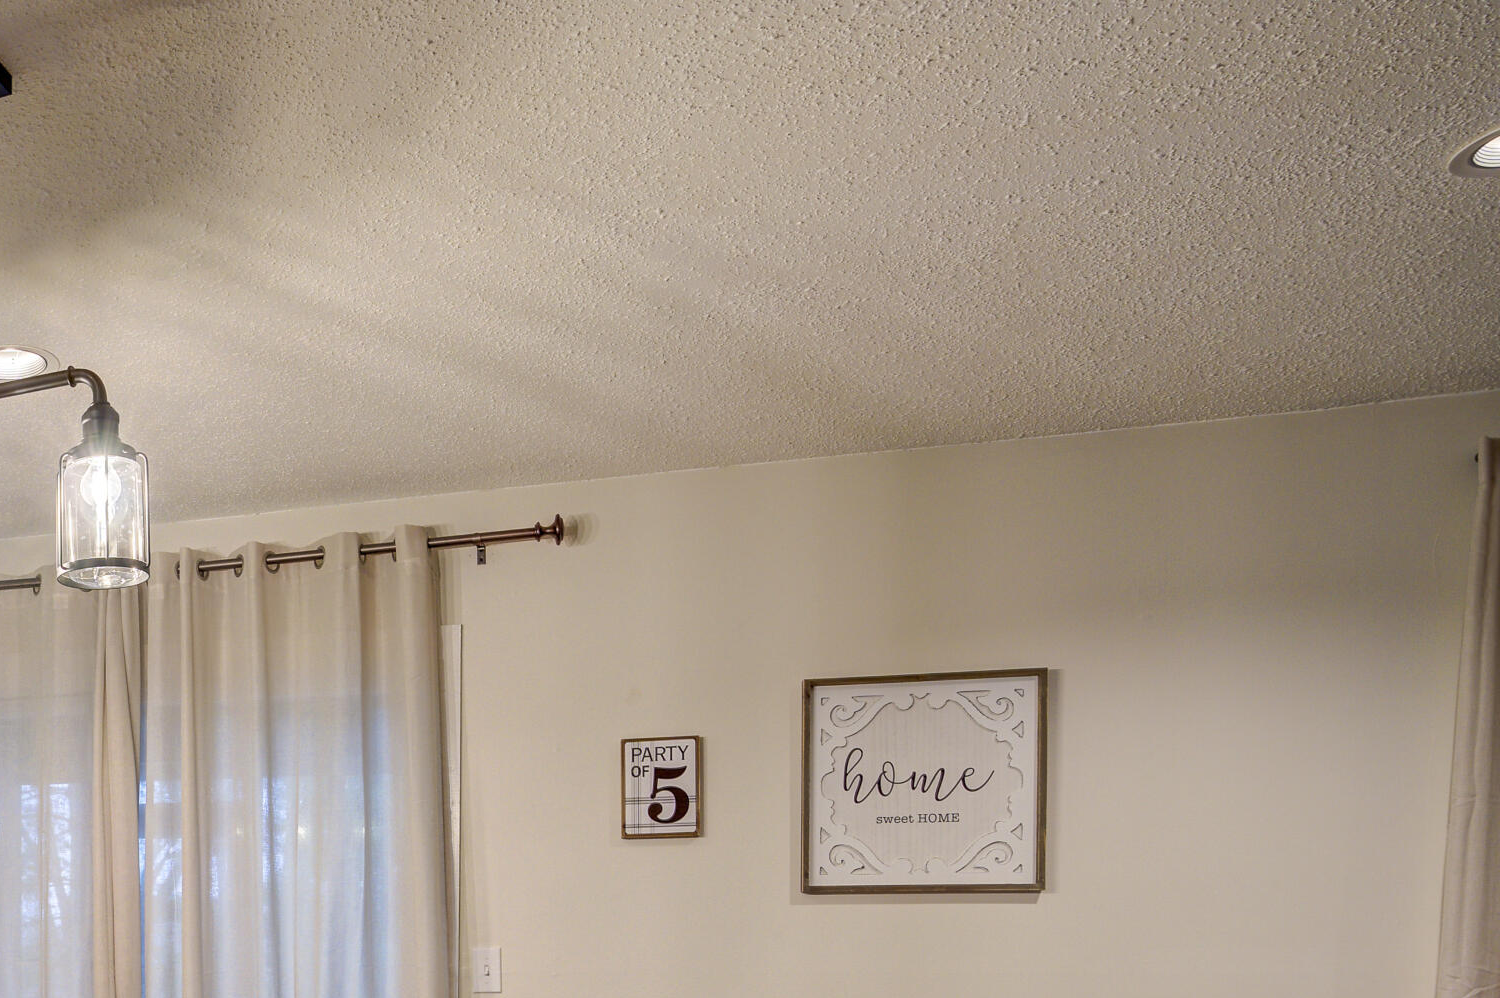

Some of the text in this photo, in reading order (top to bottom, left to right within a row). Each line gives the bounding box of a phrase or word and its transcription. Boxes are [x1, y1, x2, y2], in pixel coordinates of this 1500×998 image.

[630, 744, 689, 762] PARTY
[630, 765, 690, 823] OF 5
[843, 747, 995, 804] home
[875, 812, 960, 824] sweet HOME
